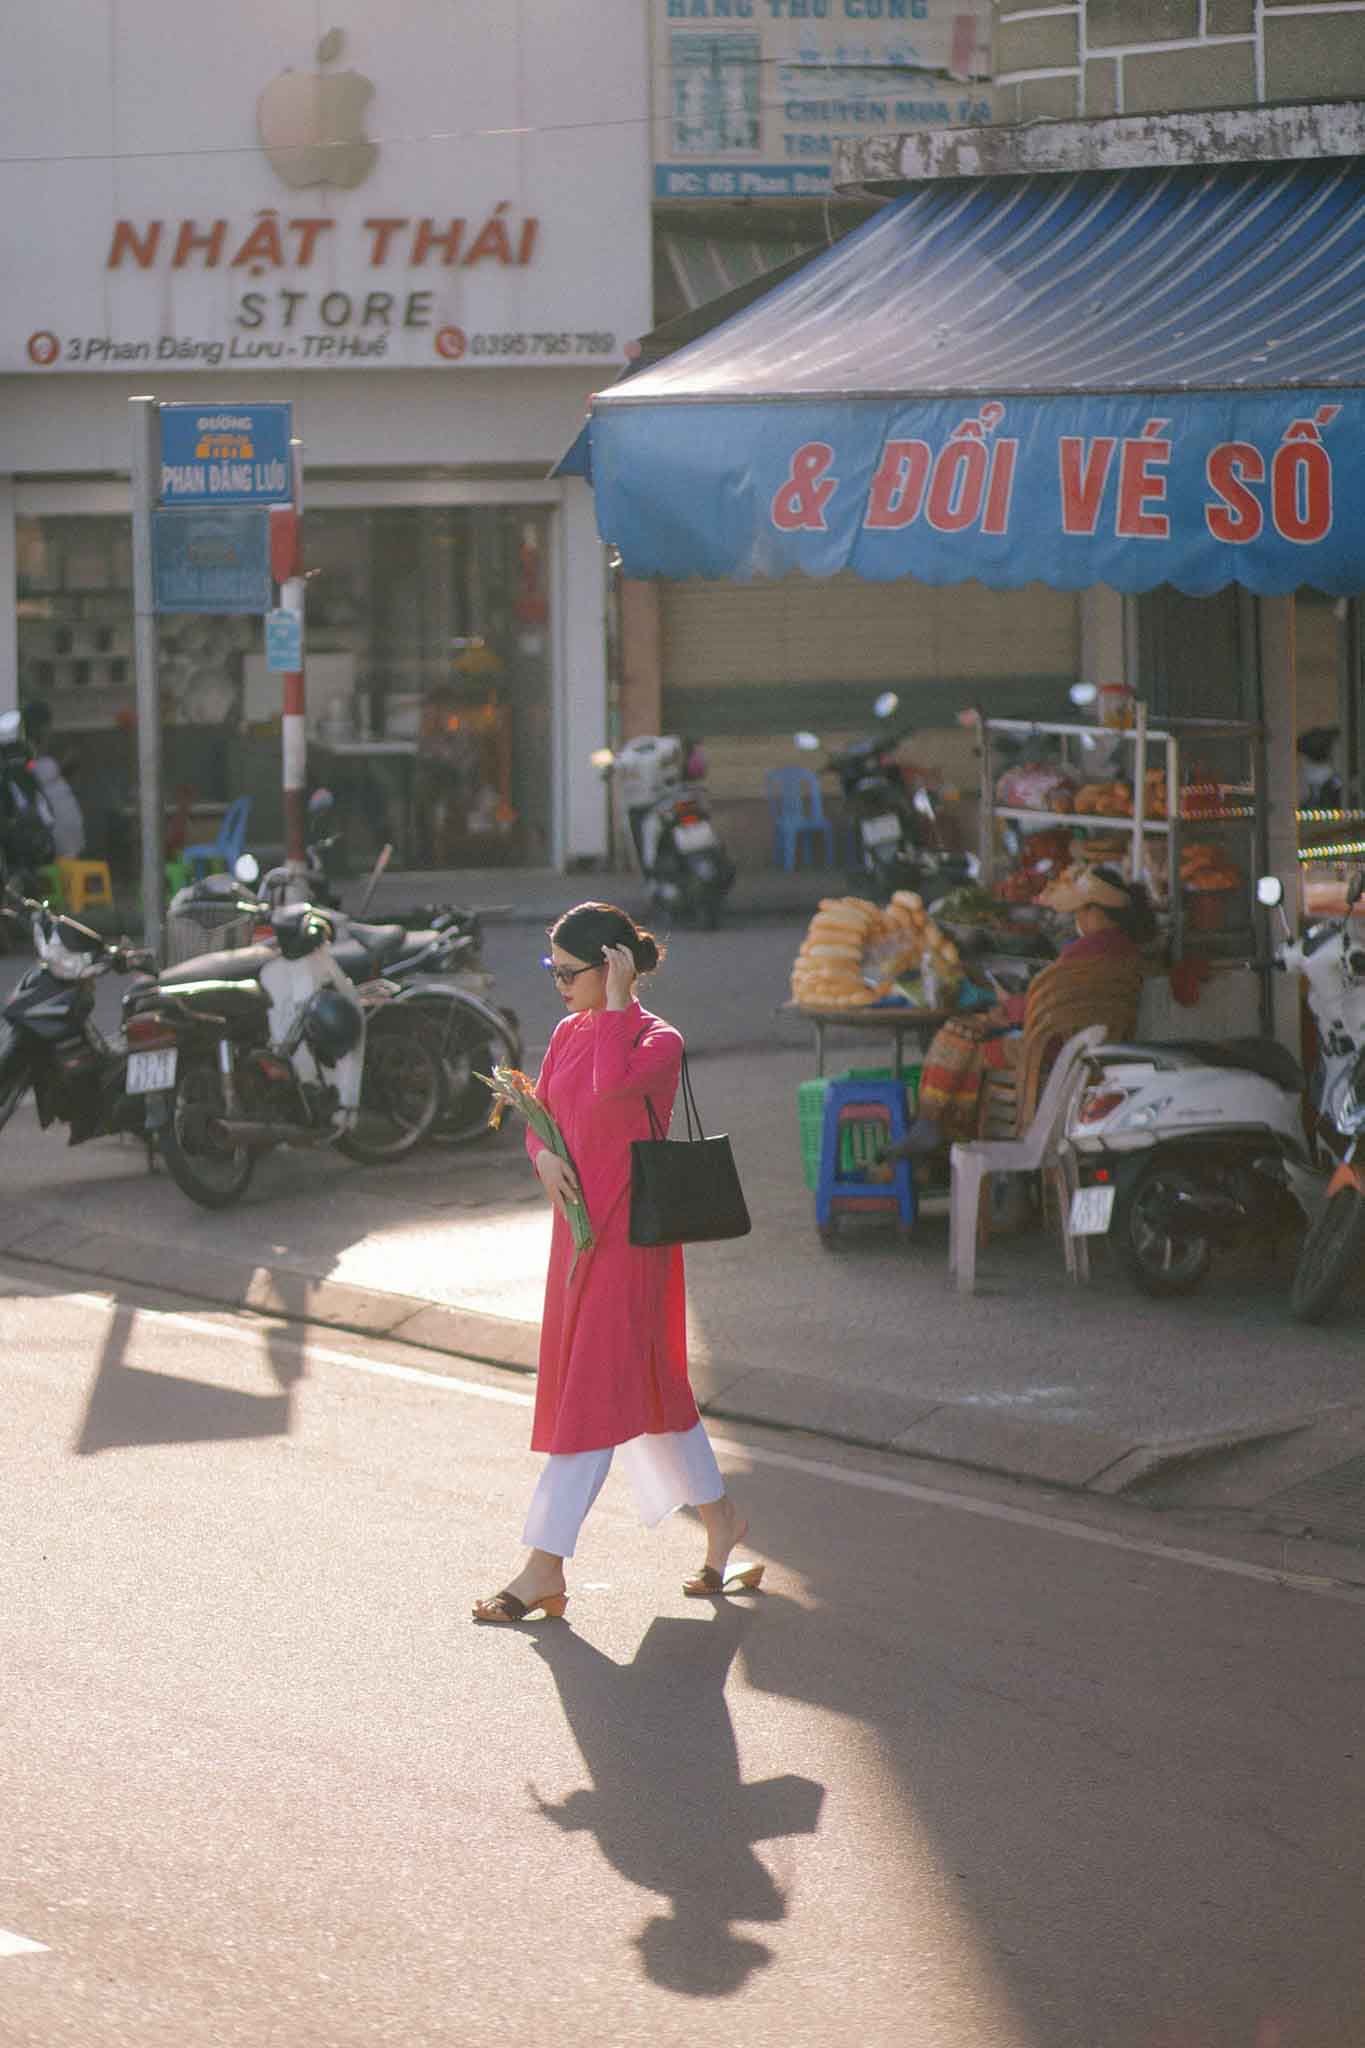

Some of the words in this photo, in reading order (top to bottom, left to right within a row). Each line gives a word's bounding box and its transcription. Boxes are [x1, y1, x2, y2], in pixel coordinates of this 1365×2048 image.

[107, 207, 336, 278] NHẬT
[363, 201, 541, 269] THÁI
[236, 292, 436, 329] STORE
[84, 338, 150, 361] Phan
[161, 464, 206, 494] PHAN
[208, 459, 253, 493] ĐĂNG
[771, 441, 839, 531] &
[862, 400, 1019, 535] ĐỔI
[1058, 418, 1173, 540] VÉ
[1203, 404, 1345, 544] SỐ
